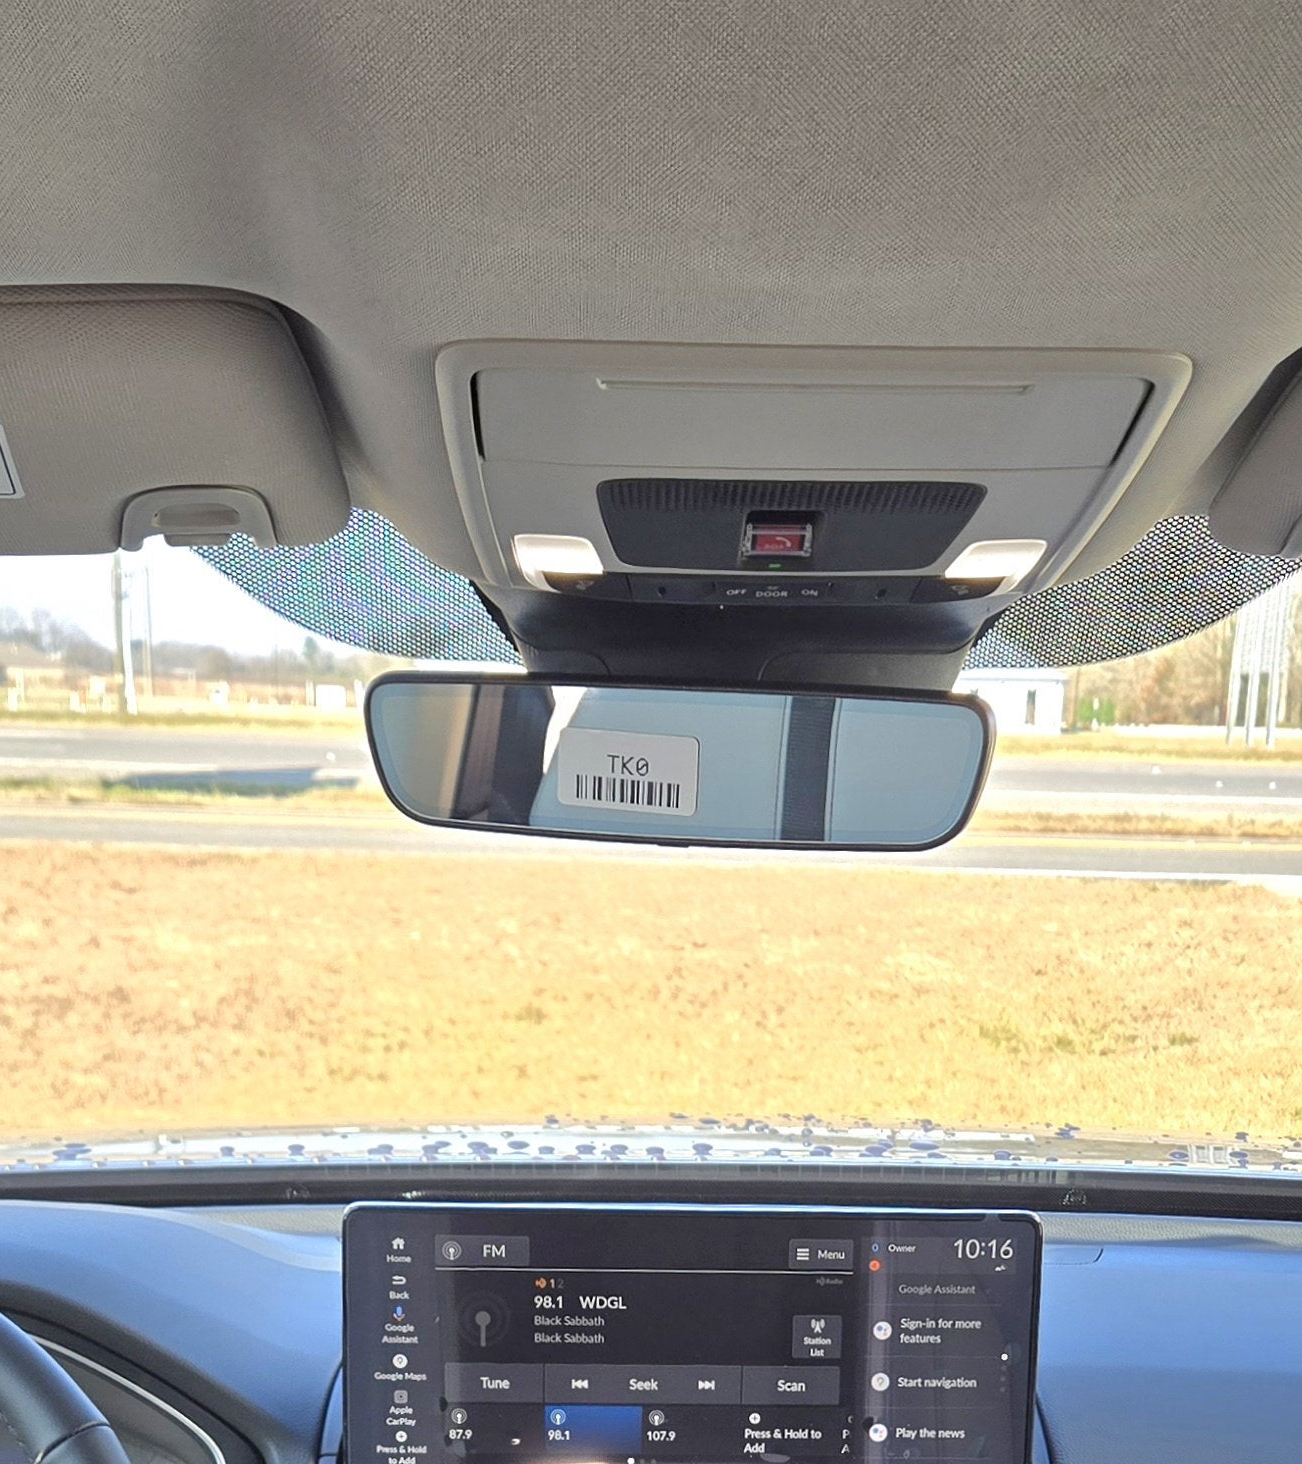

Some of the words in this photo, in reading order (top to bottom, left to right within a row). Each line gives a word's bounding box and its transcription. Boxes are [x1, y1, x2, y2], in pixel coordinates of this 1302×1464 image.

[607, 754, 649, 777] TK0
[482, 1244, 506, 1258] FM
[888, 1243, 916, 1253] Owner
[954, 1238, 1014, 1259] 10:16
[386, 1254, 412, 1263] Home
[818, 1249, 845, 1260] Menu
[389, 1290, 410, 1300] Back
[898, 1284, 933, 1296] Google
[934, 1284, 976, 1295] Assistant
[533, 1295, 563, 1309] 98.1
[579, 1295, 627, 1310] WDGL
[534, 1315, 562, 1326] Black
[563, 1315, 605, 1326] Sabbath
[900, 1318, 936, 1331] Sign-in
[937, 1318, 953, 1329] for
[955, 1320, 982, 1329] more
[384, 1323, 415, 1333] Google
[381, 1335, 419, 1344] Assistant
[534, 1332, 562, 1343] Black
[564, 1332, 605, 1344] Sabbath
[803, 1336, 832, 1345] Station
[900, 1333, 942, 1344] features
[810, 1348, 825, 1357] List
[373, 1371, 404, 1382] Google
[404, 1372, 427, 1381] Maps
[480, 1377, 511, 1389] Tune
[629, 1378, 658, 1391] Seek
[777, 1380, 806, 1392] Scan
[897, 1377, 922, 1388] Start
[924, 1377, 977, 1389] navigation
[389, 1405, 413, 1415] Apple
[385, 1417, 417, 1427] CarPlay
[448, 1428, 472, 1440] 87.9
[547, 1430, 570, 1441] 98.1
[646, 1430, 676, 1441] 107.9
[744, 1429, 771, 1439] Press
[772, 1429, 782, 1439] &
[784, 1429, 808, 1439] Hold
[810, 1430, 822, 1439] to
[895, 1428, 917, 1440] Play
[919, 1428, 936, 1438] the
[938, 1430, 965, 1439] news
[376, 1444, 397, 1454] Press
[399, 1445, 406, 1454] &
[407, 1445, 428, 1454] Hold
[744, 1442, 765, 1453] Add
[388, 1457, 398, 1464] to
[398, 1456, 416, 1464] Add
